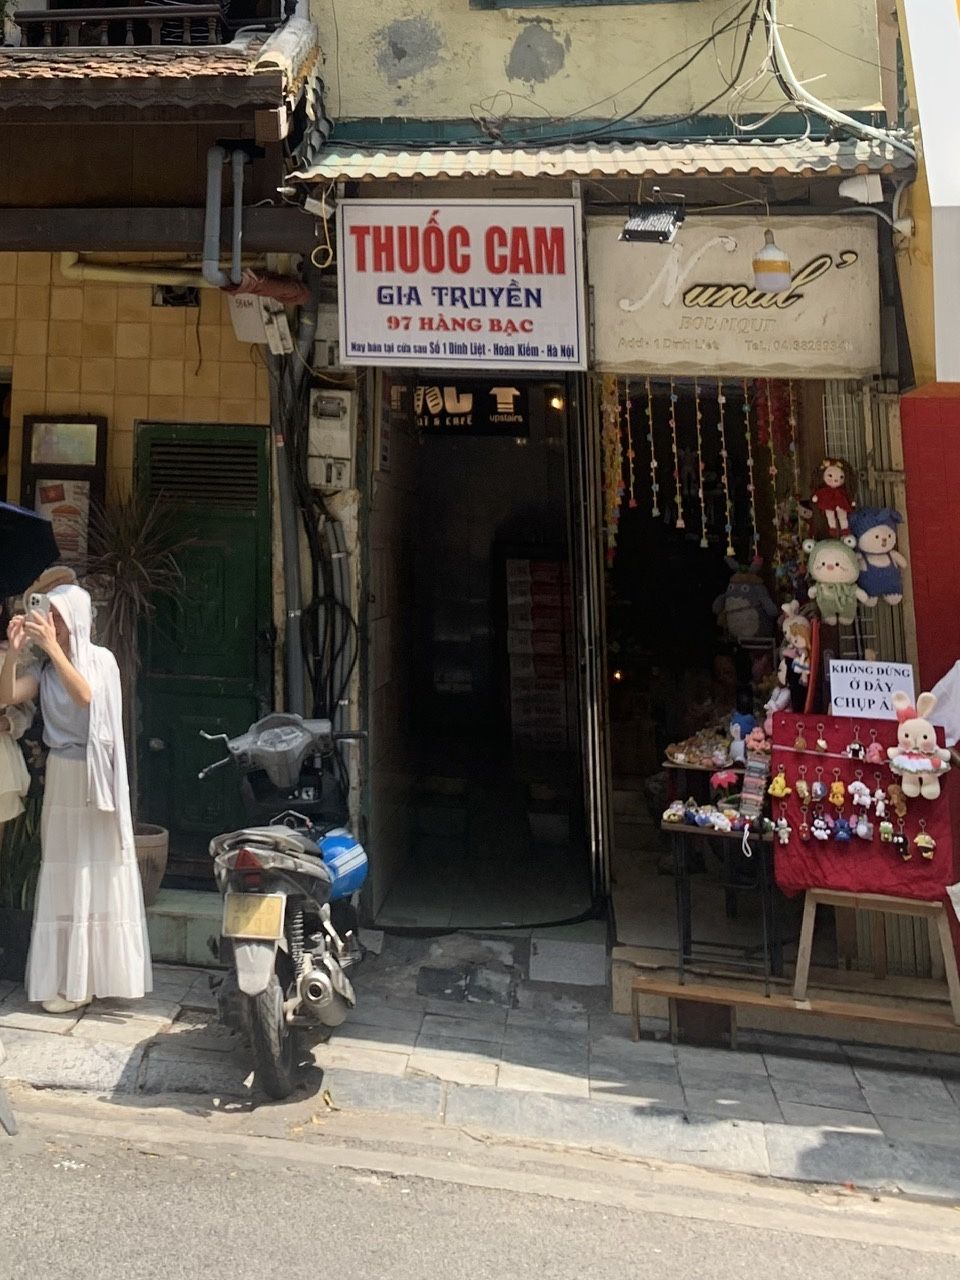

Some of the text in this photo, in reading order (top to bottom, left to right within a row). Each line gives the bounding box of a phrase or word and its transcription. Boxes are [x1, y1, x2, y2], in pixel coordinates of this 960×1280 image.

[349, 209, 566, 276] THUỐC CAM
[376, 279, 542, 309] GIA TRUYỀN
[386, 313, 534, 336] 97 HÀNG BẠC
[351, 342, 365, 353] Nay
[413, 344, 427, 353] sau
[429, 339, 440, 354] Số
[442, 342, 447, 354] 1
[493, 343, 514, 356] Hoàn
[547, 344, 558, 357] Hà
[489, 414, 523, 423] upstairs
[832, 663, 873, 675] KHÔNG
[834, 696, 876, 712] CHỤP
